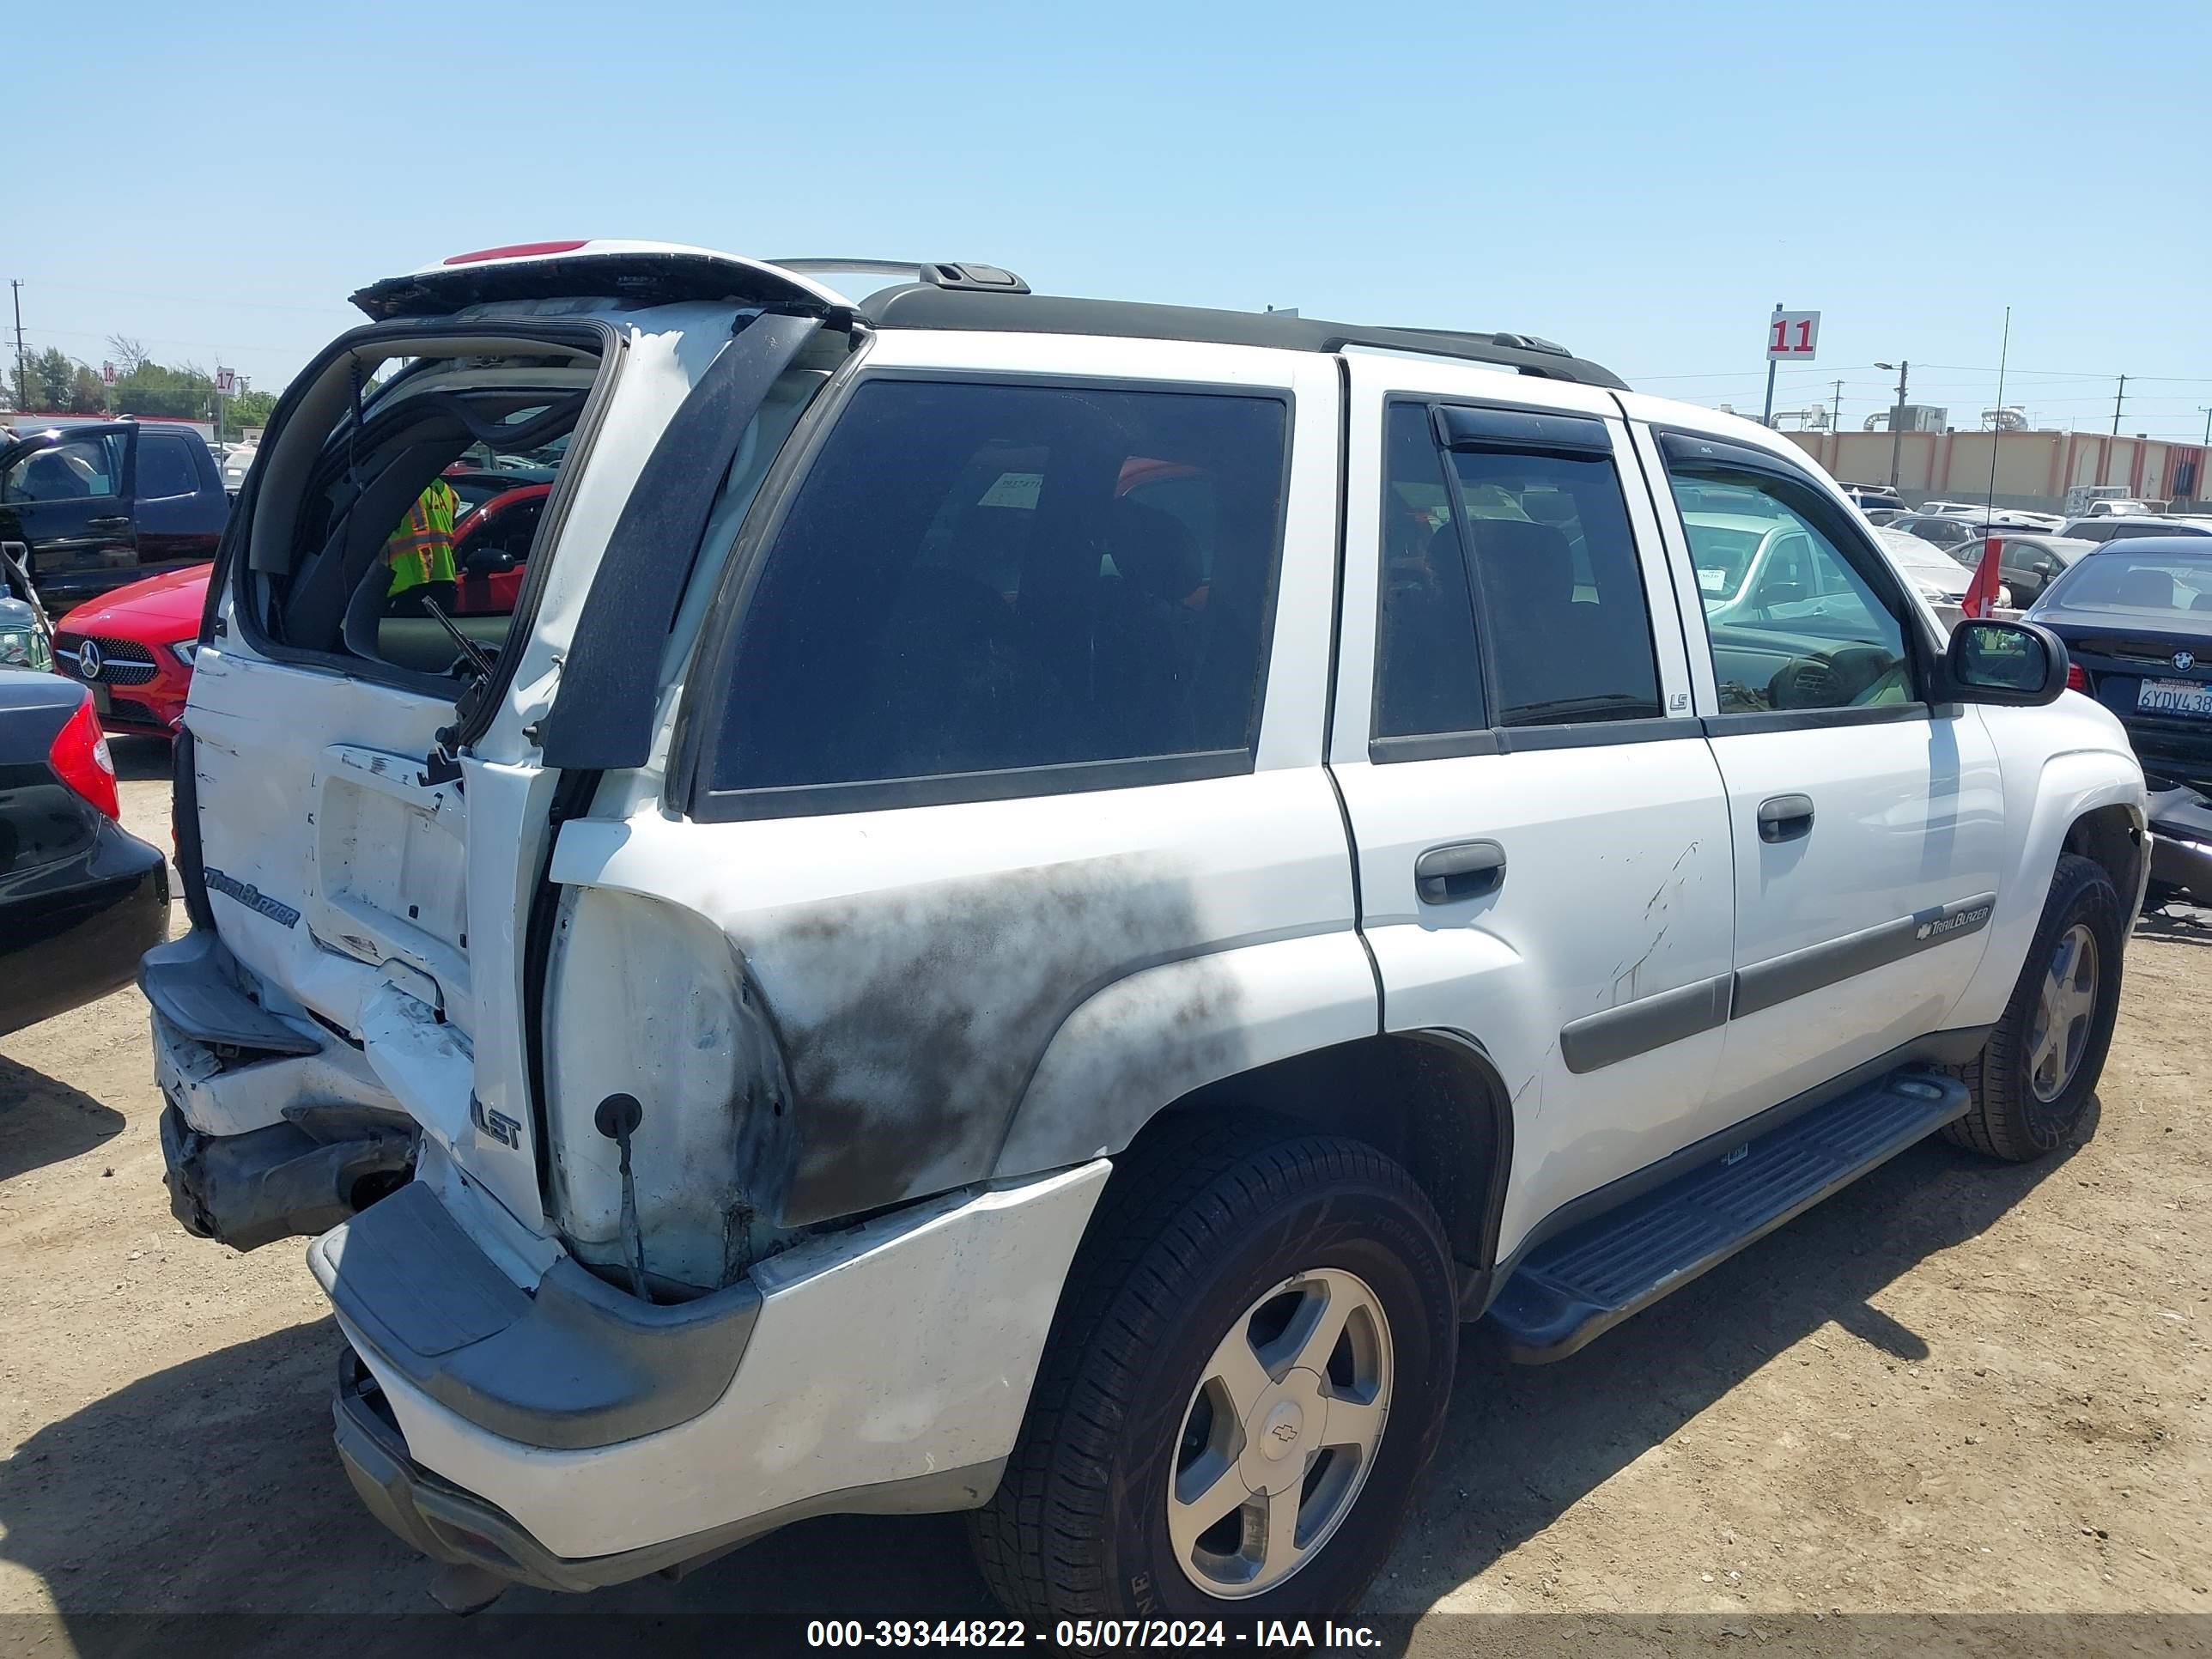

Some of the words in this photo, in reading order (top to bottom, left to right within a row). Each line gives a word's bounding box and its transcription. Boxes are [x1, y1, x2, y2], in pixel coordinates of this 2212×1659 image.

[1770, 319, 1814, 351] 11
[104, 367, 114, 382] 18
[217, 372, 234, 389] 17
[1669, 693, 1688, 710] LS
[2142, 690, 2212, 712] 6YDV438
